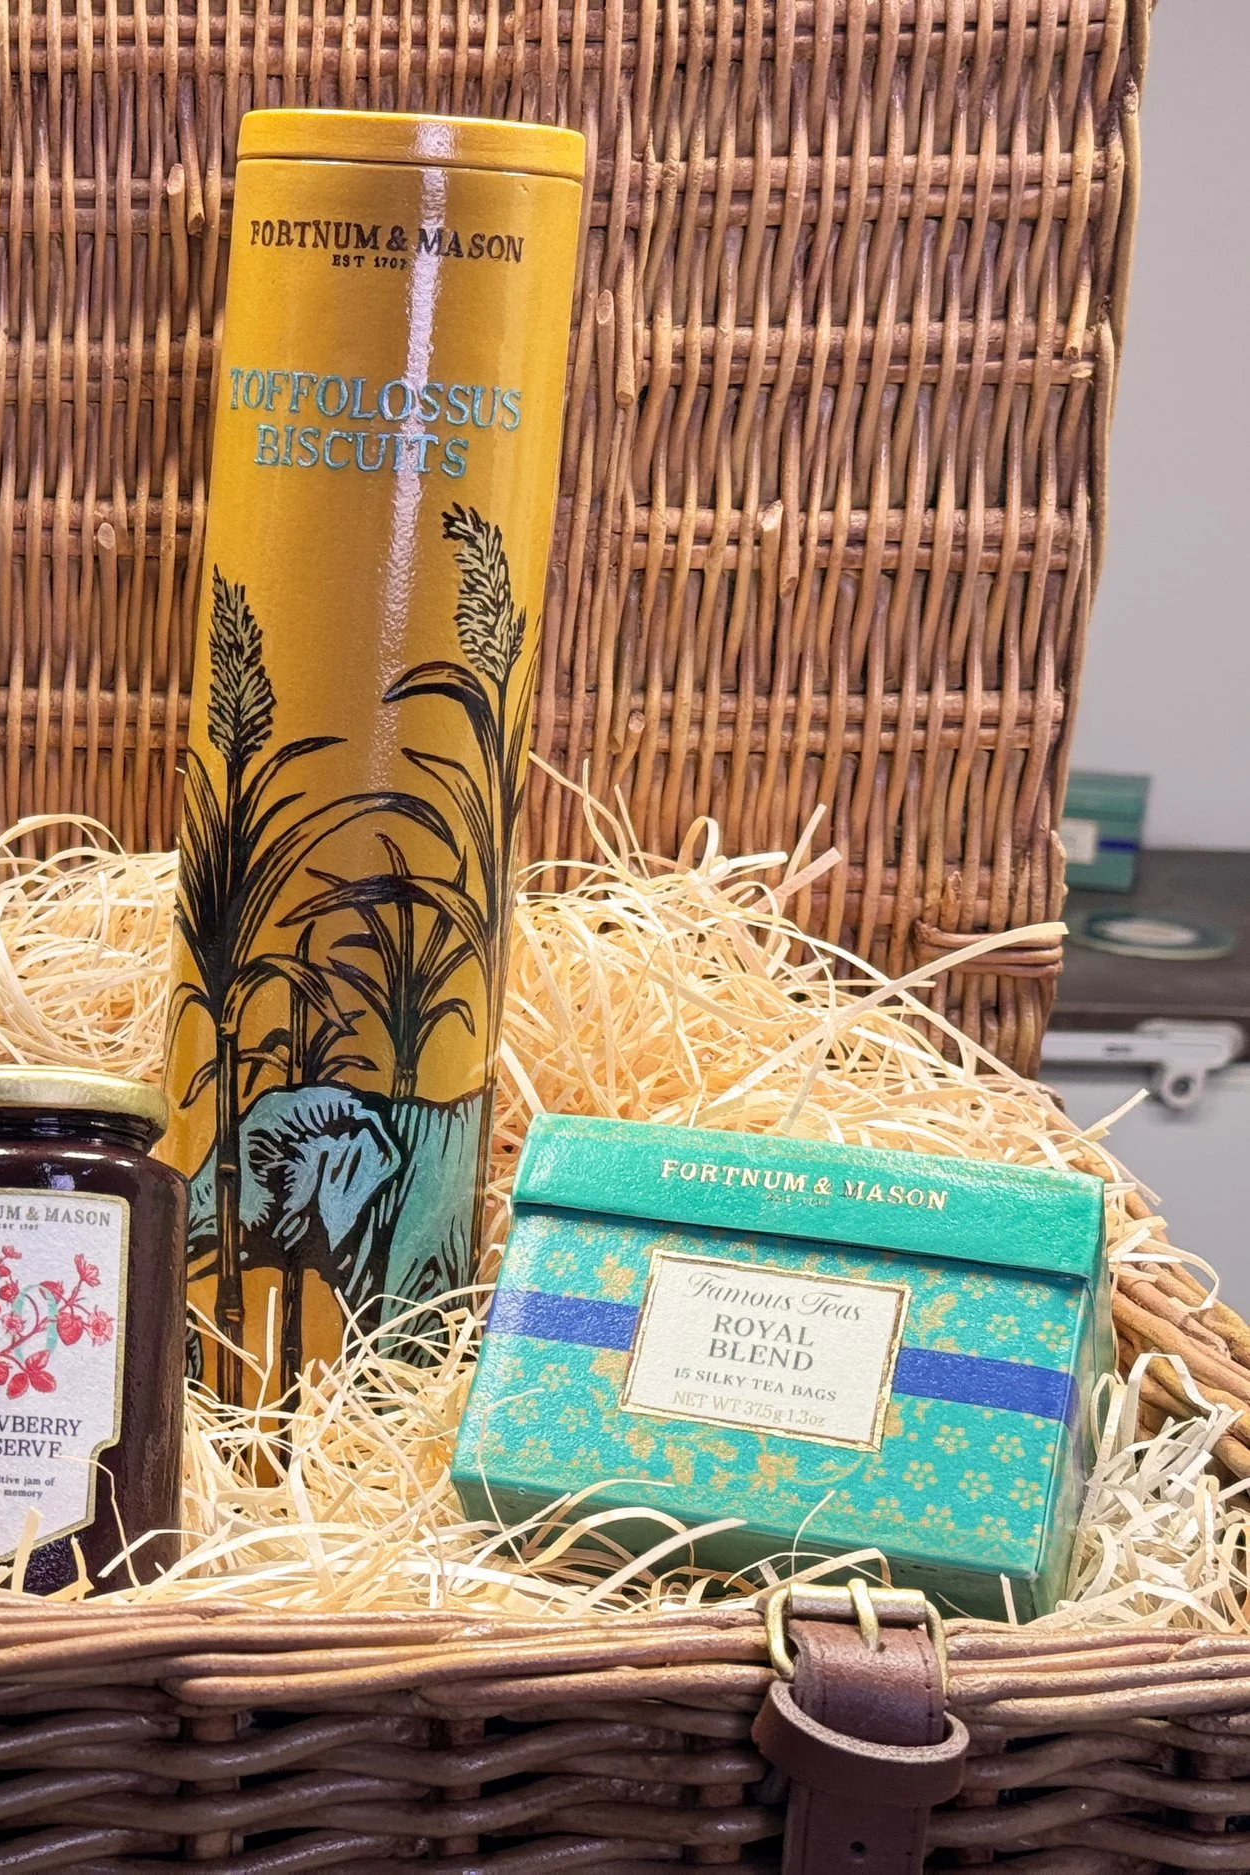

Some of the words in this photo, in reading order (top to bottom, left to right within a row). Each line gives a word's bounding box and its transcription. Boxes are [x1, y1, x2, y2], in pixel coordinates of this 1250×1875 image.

[250, 219, 382, 250] FORTNUM
[385, 225, 408, 251] &
[417, 228, 525, 264] MASON
[331, 254, 365, 268] EST
[230, 367, 522, 431] TOFFOLOSSUS
[253, 424, 469, 479] BISCUITS
[660, 1159, 808, 1193] FORTNUM
[813, 1176, 832, 1196] &
[841, 1179, 948, 1211] MASON
[25, 1207, 40, 1221] &
[44, 1207, 111, 1227] MASON
[684, 1272, 795, 1311] Famous
[796, 1291, 864, 1321] Teas
[712, 1313, 815, 1347] ROYAL
[708, 1338, 814, 1371] BLEND
[674, 1367, 690, 1379] 15
[695, 1369, 747, 1387] SILKY
[752, 1378, 784, 1394] TEA
[791, 1385, 836, 1402] BAGS
[671, 1391, 708, 1409] NET
[713, 1395, 742, 1413] WT
[4, 1489, 42, 1499] memory
[24, 1476, 41, 1487] jam
[44, 1477, 56, 1487] of
